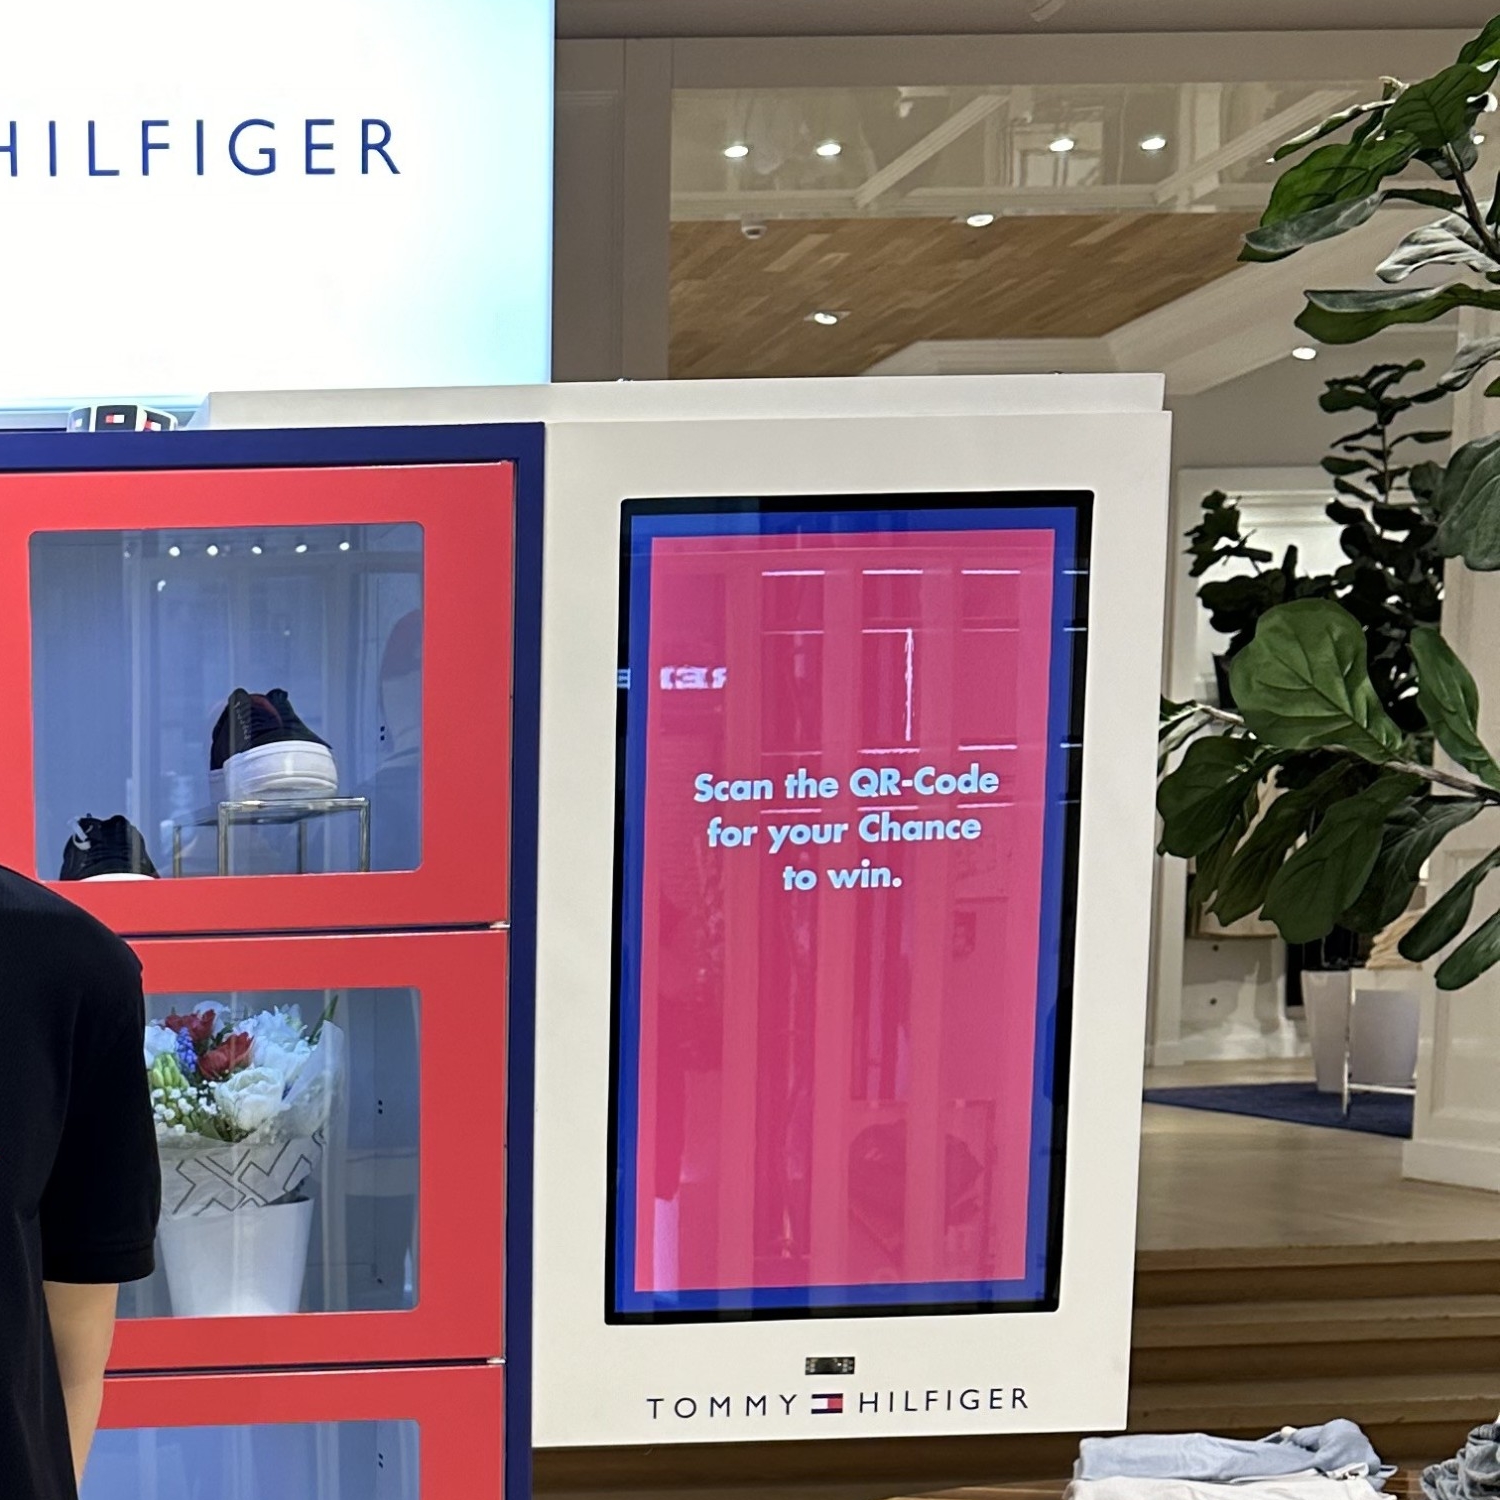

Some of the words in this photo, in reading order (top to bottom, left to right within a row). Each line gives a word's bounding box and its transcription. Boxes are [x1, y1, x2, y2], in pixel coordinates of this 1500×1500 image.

[694, 774, 772, 802] Scan
[785, 769, 838, 798] the
[850, 763, 998, 797] QR-Code
[708, 817, 757, 846] for
[768, 824, 848, 853] your
[859, 812, 981, 842] Chance
[783, 866, 816, 890] to
[828, 859, 901, 888] win.
[647, 1395, 796, 1419] TOMMY
[860, 1388, 1028, 1413] HILFIGER
